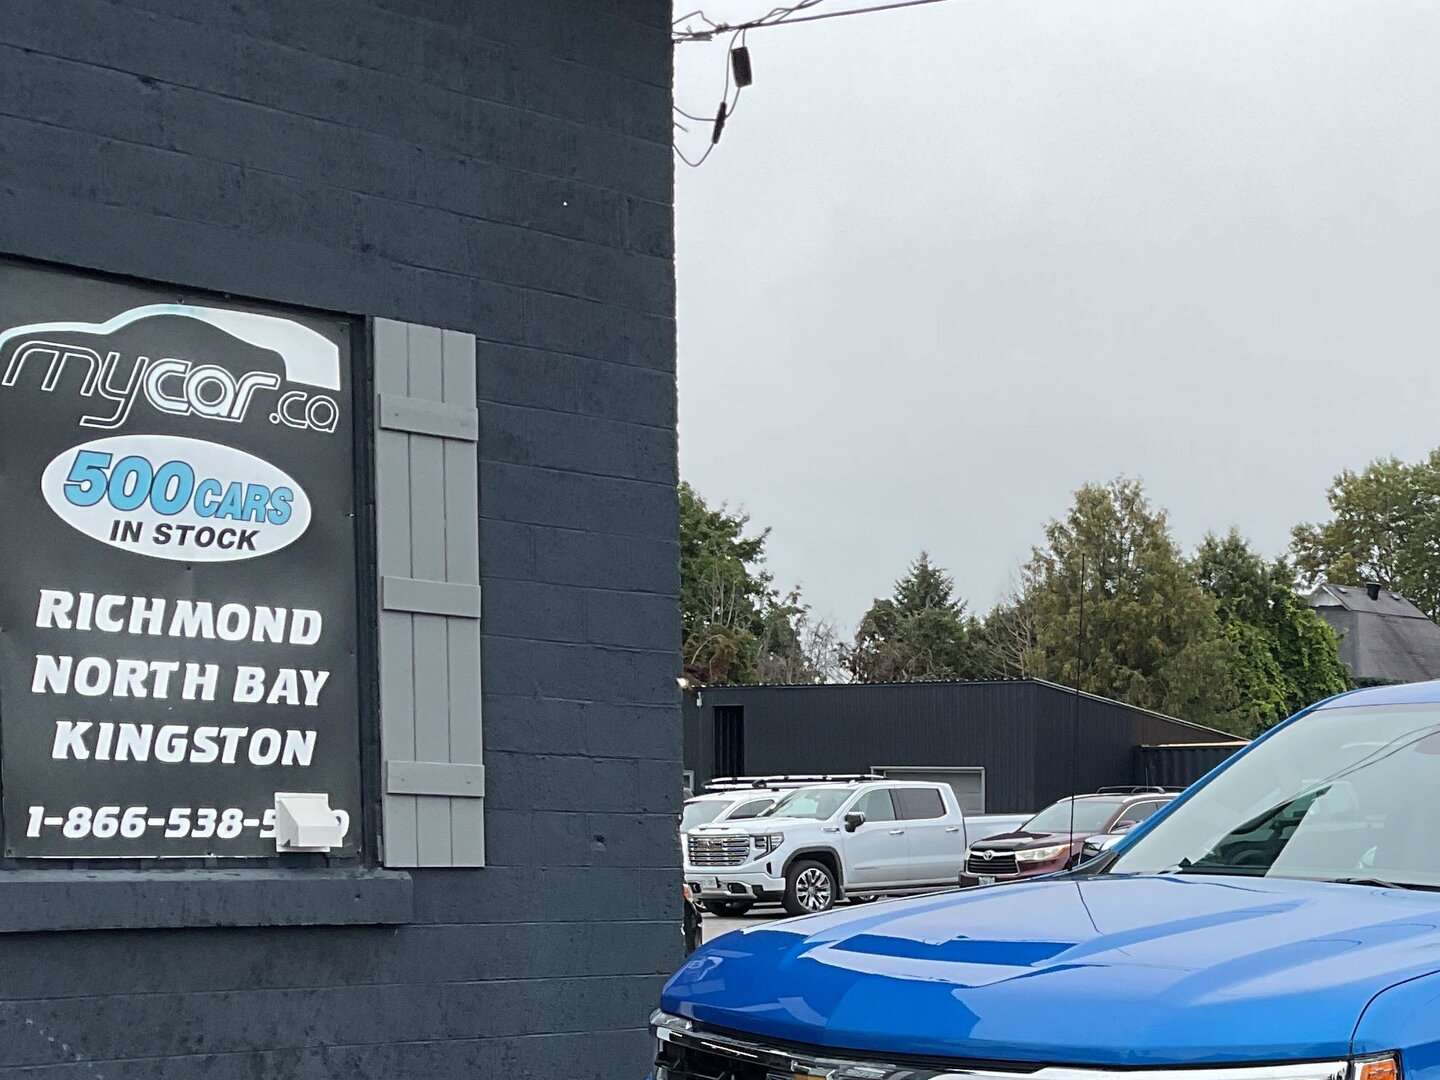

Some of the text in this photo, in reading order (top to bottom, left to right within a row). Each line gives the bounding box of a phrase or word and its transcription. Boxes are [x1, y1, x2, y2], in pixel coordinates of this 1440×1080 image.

[64, 450, 294, 525] 500 CARS
[109, 519, 260, 551] IN STOCK
[35, 589, 323, 646] RICHMOND
[31, 654, 330, 706] NORTH BAY
[51, 720, 317, 766] KINGSTON
